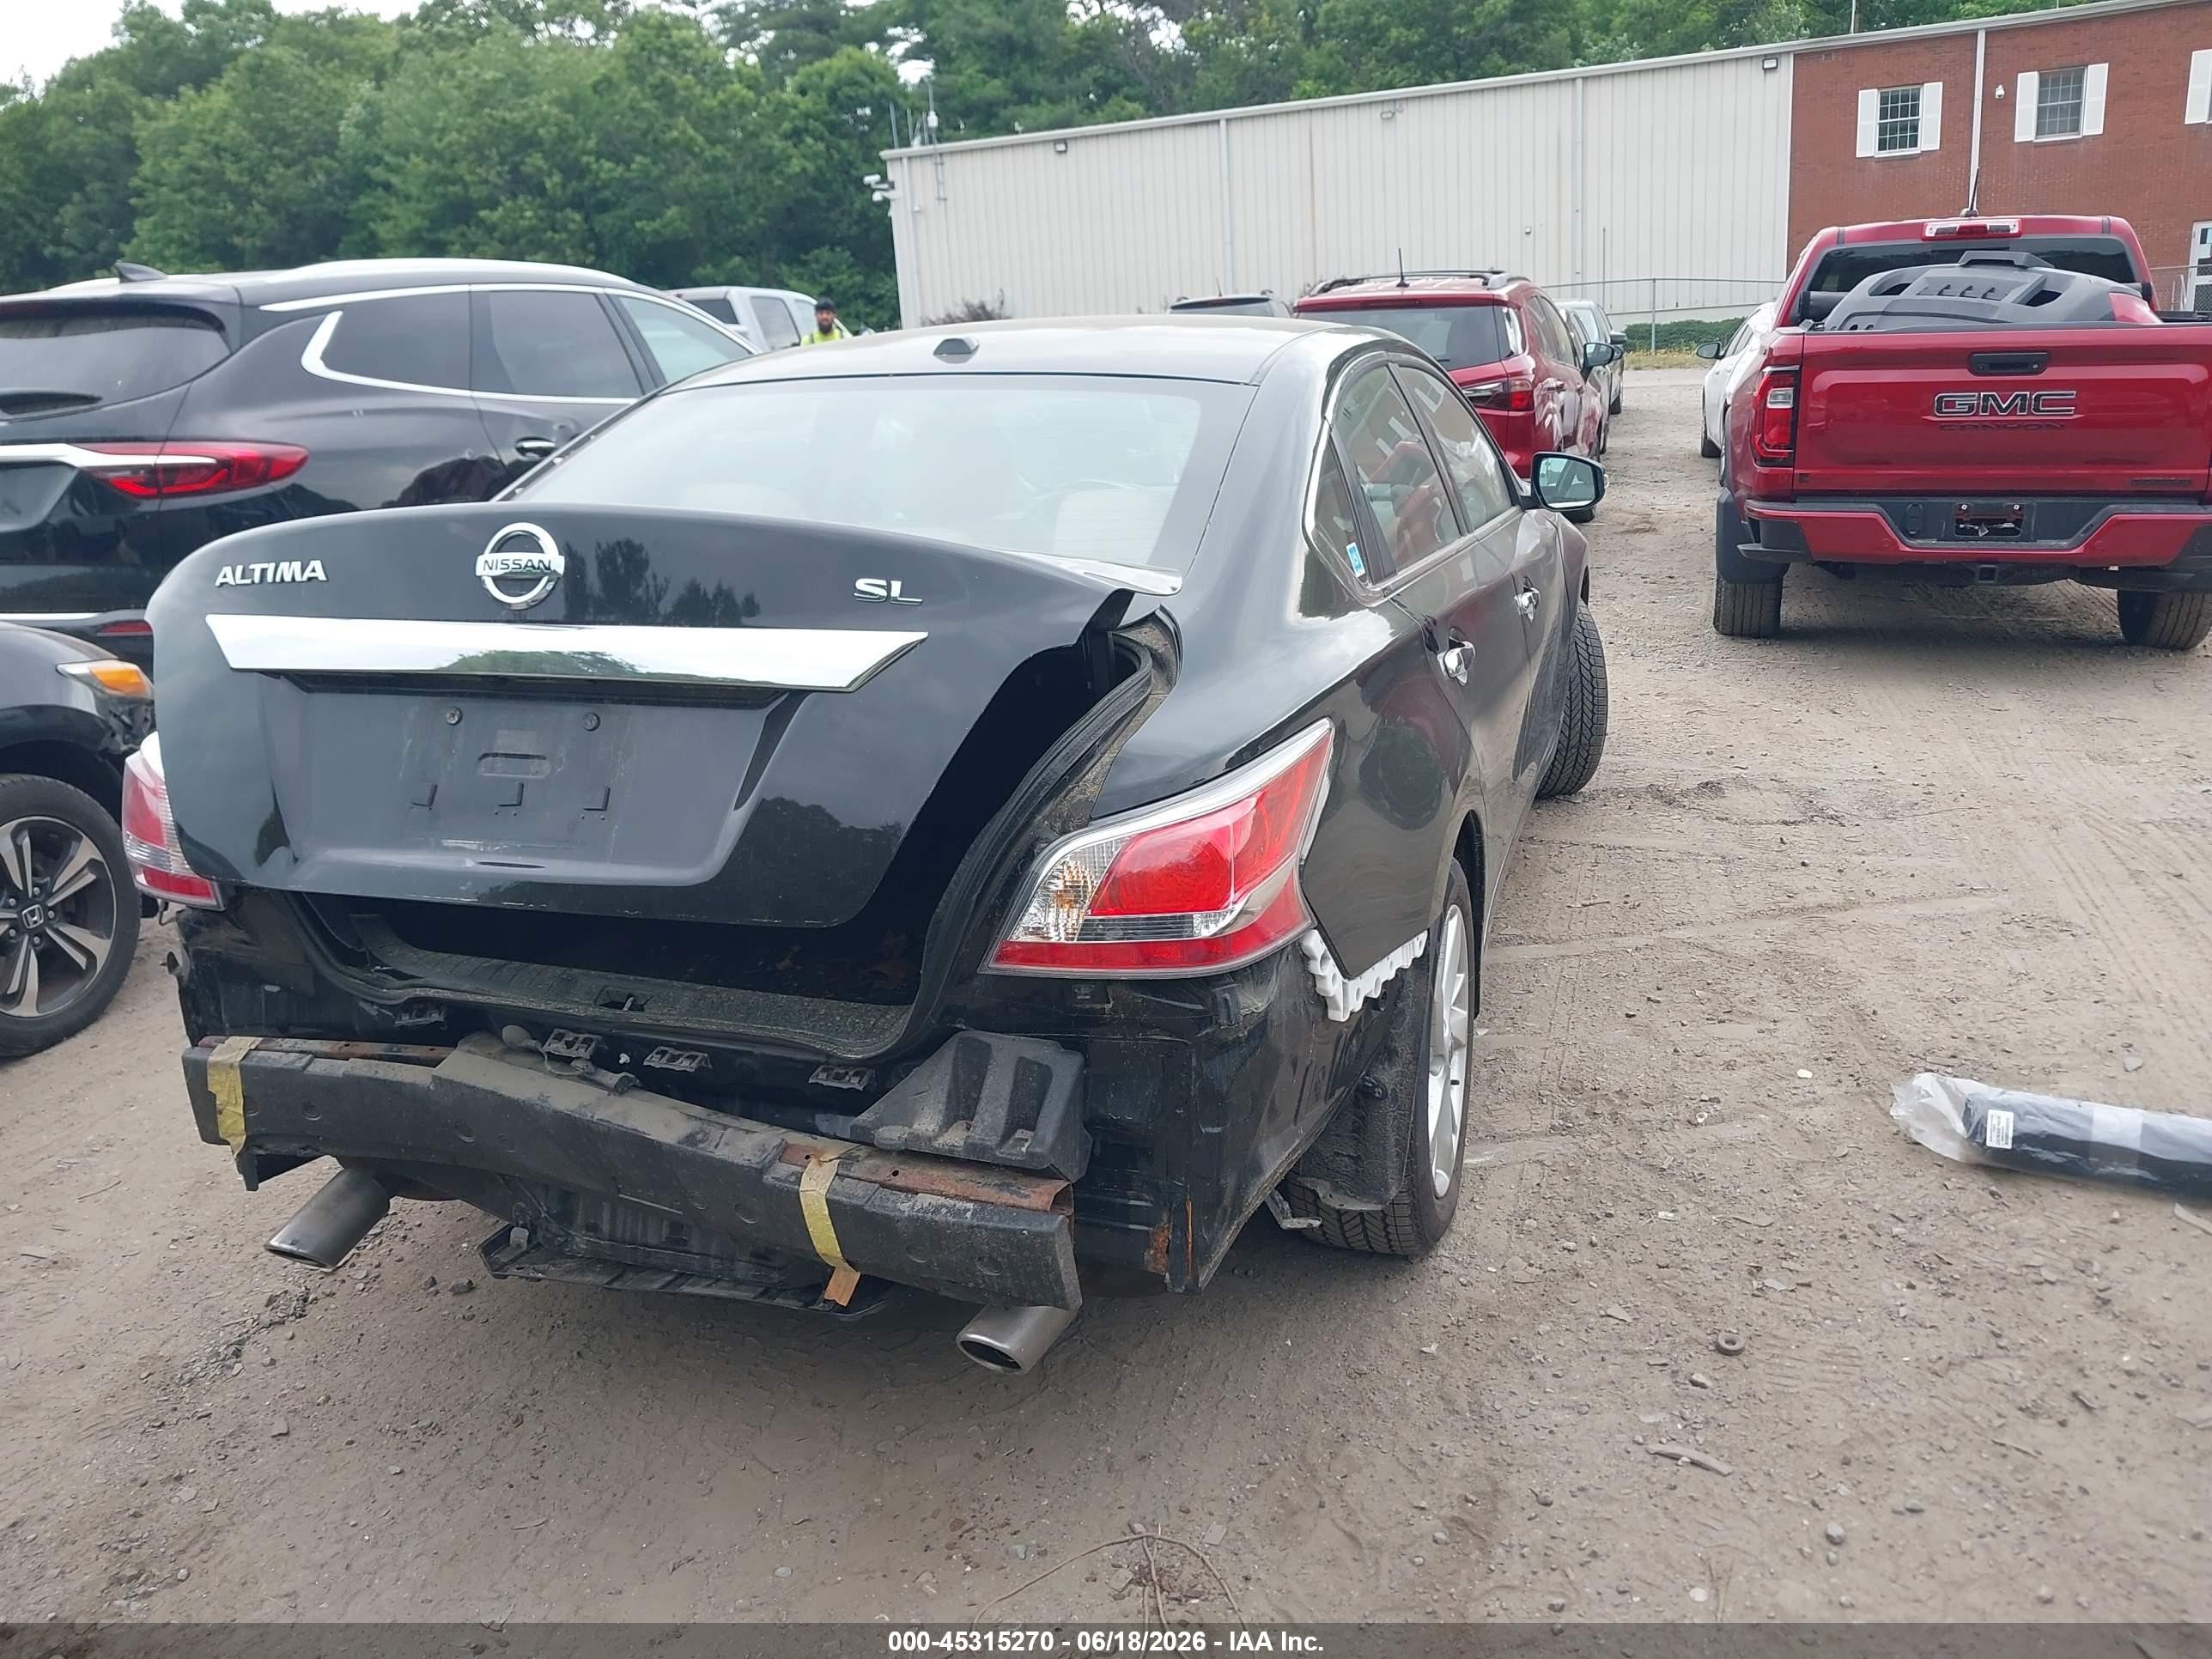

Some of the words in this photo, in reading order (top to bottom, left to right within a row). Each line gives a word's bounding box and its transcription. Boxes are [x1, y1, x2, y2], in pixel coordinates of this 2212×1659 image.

[1934, 391, 2077, 416] GMC
[215, 559, 328, 587] ALTIMA
[483, 558, 551, 571] NISSAN
[853, 578, 924, 605] SL
